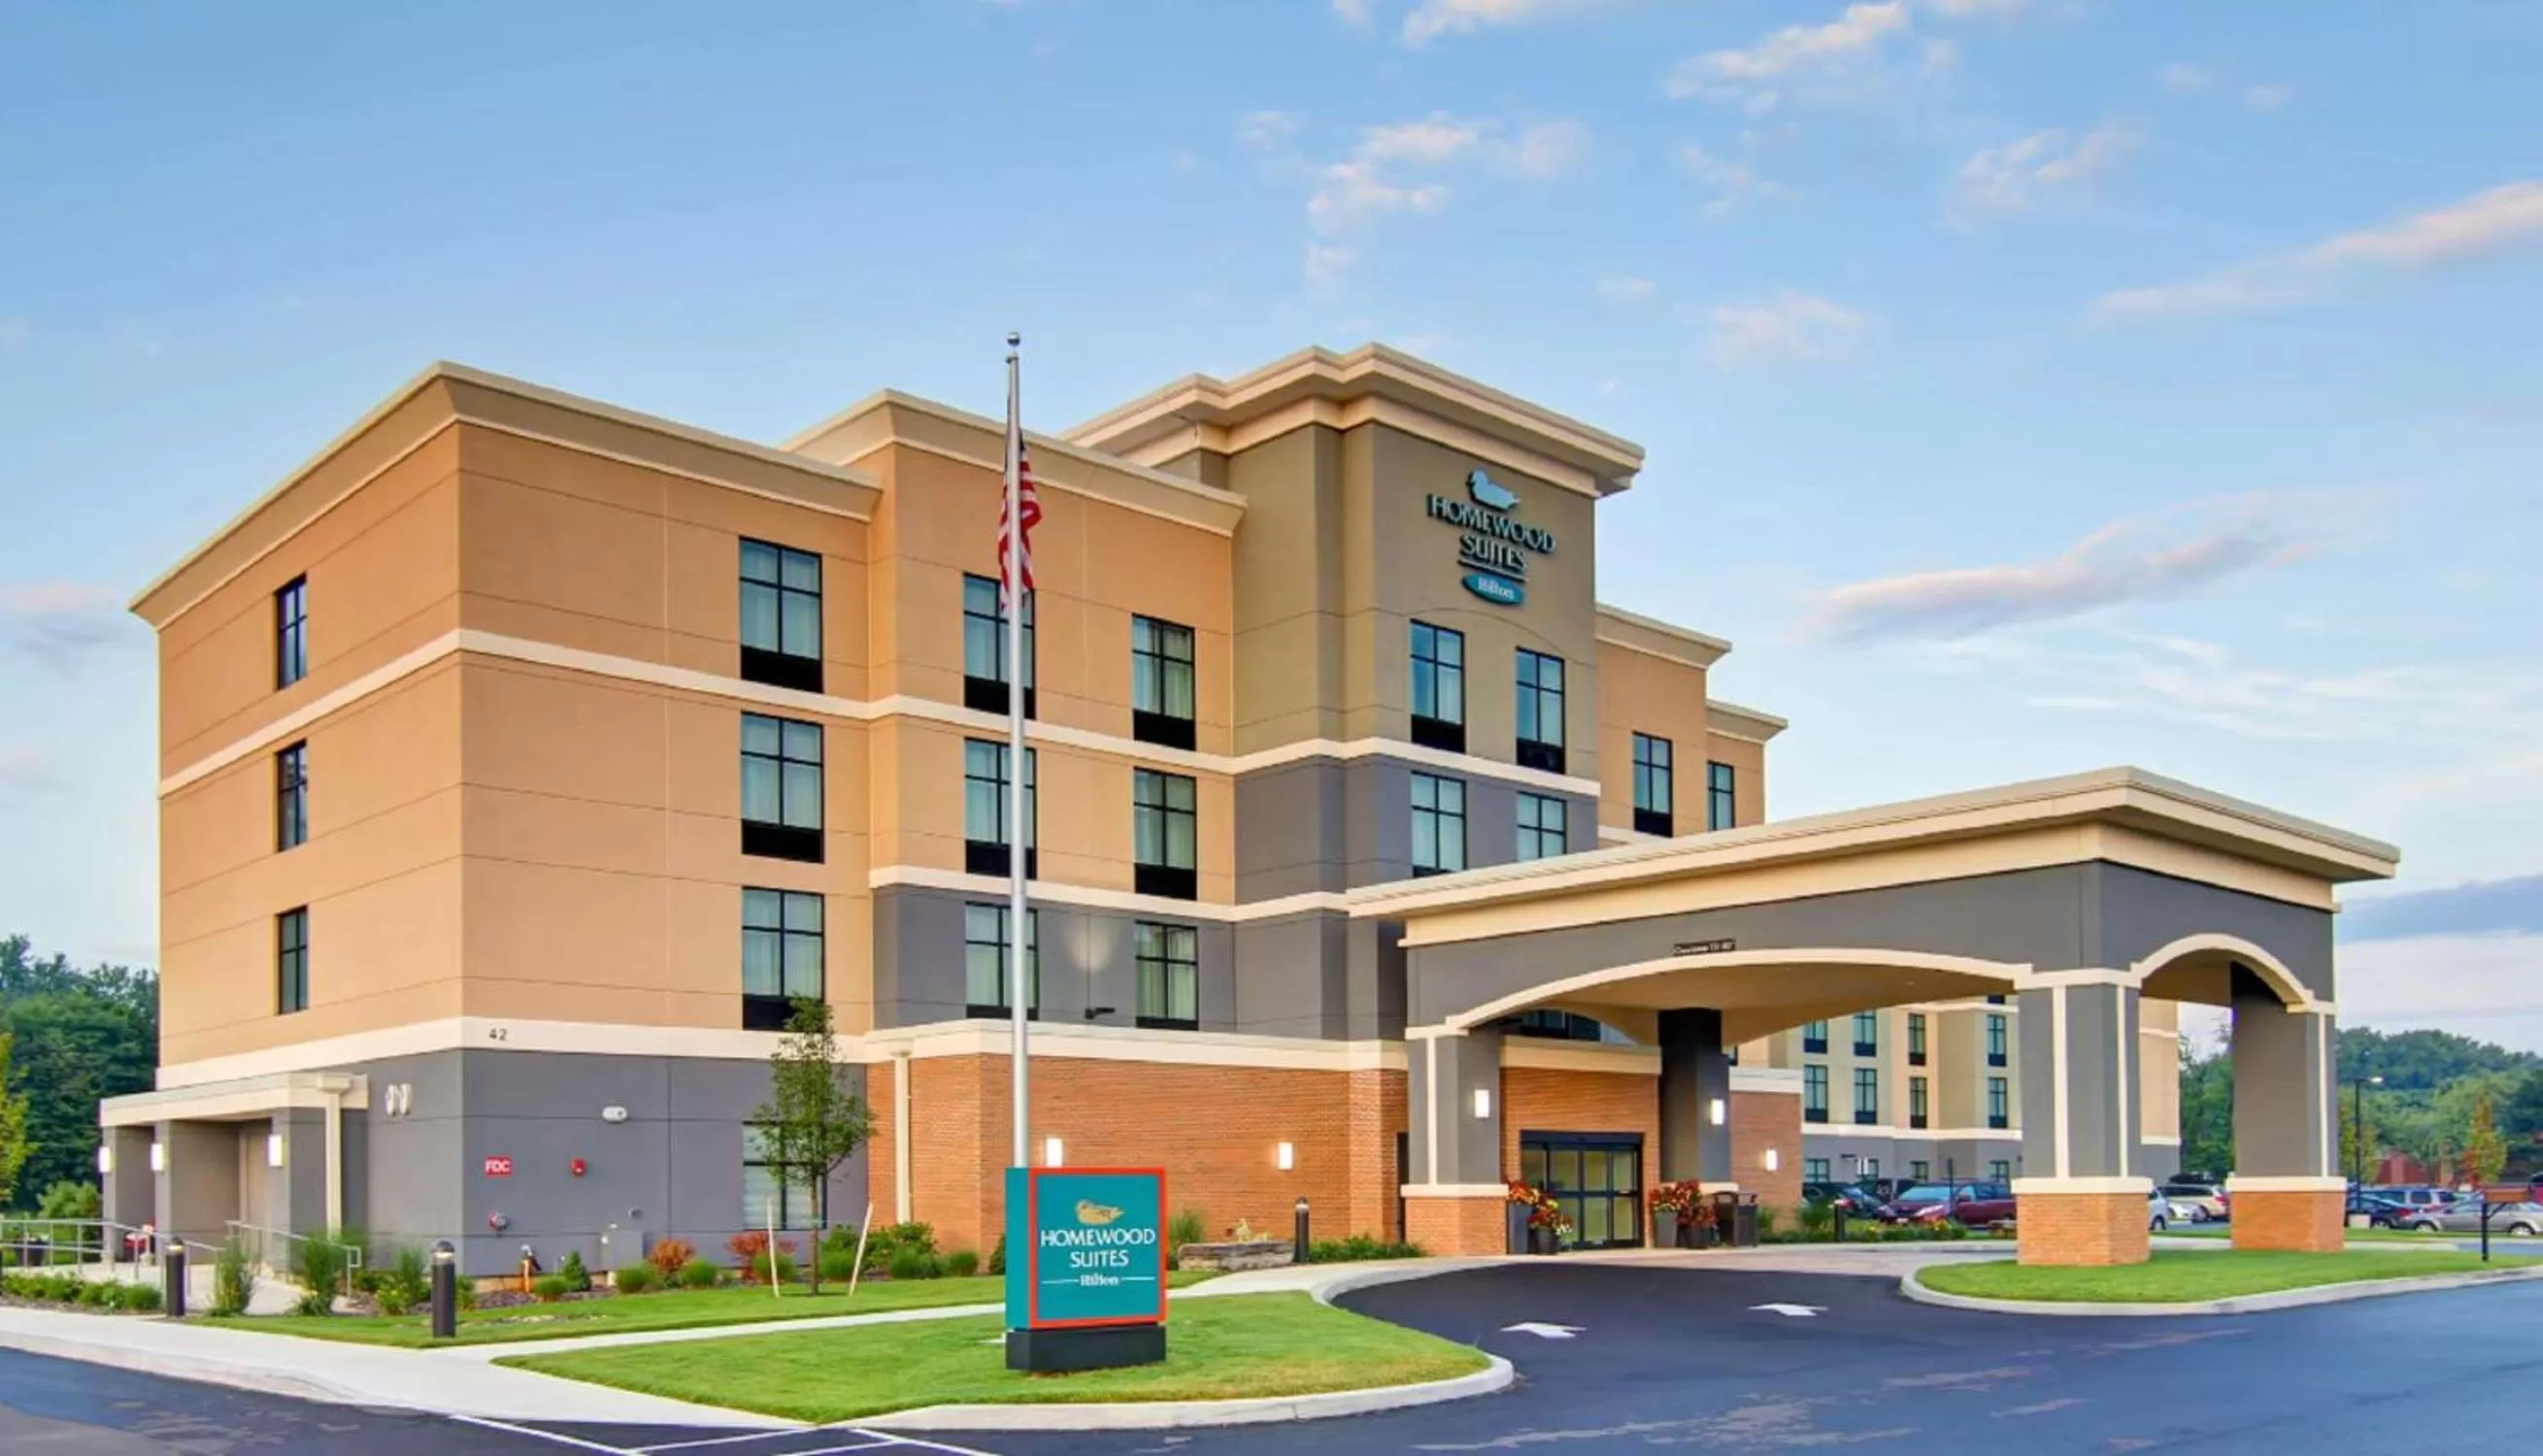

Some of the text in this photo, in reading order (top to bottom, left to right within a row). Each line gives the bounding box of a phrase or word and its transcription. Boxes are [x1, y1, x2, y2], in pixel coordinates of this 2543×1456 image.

[1427, 494, 1557, 555] HOMEWOOD
[1459, 534, 1528, 571] SUITES
[1477, 577, 1516, 601] Hilton
[488, 1027, 509, 1042] 42
[485, 1159, 511, 1173] FDC
[1040, 1227, 1156, 1247] HOMEWOOD
[1070, 1249, 1129, 1269] SUITES
[1080, 1273, 1120, 1286] Hilton
